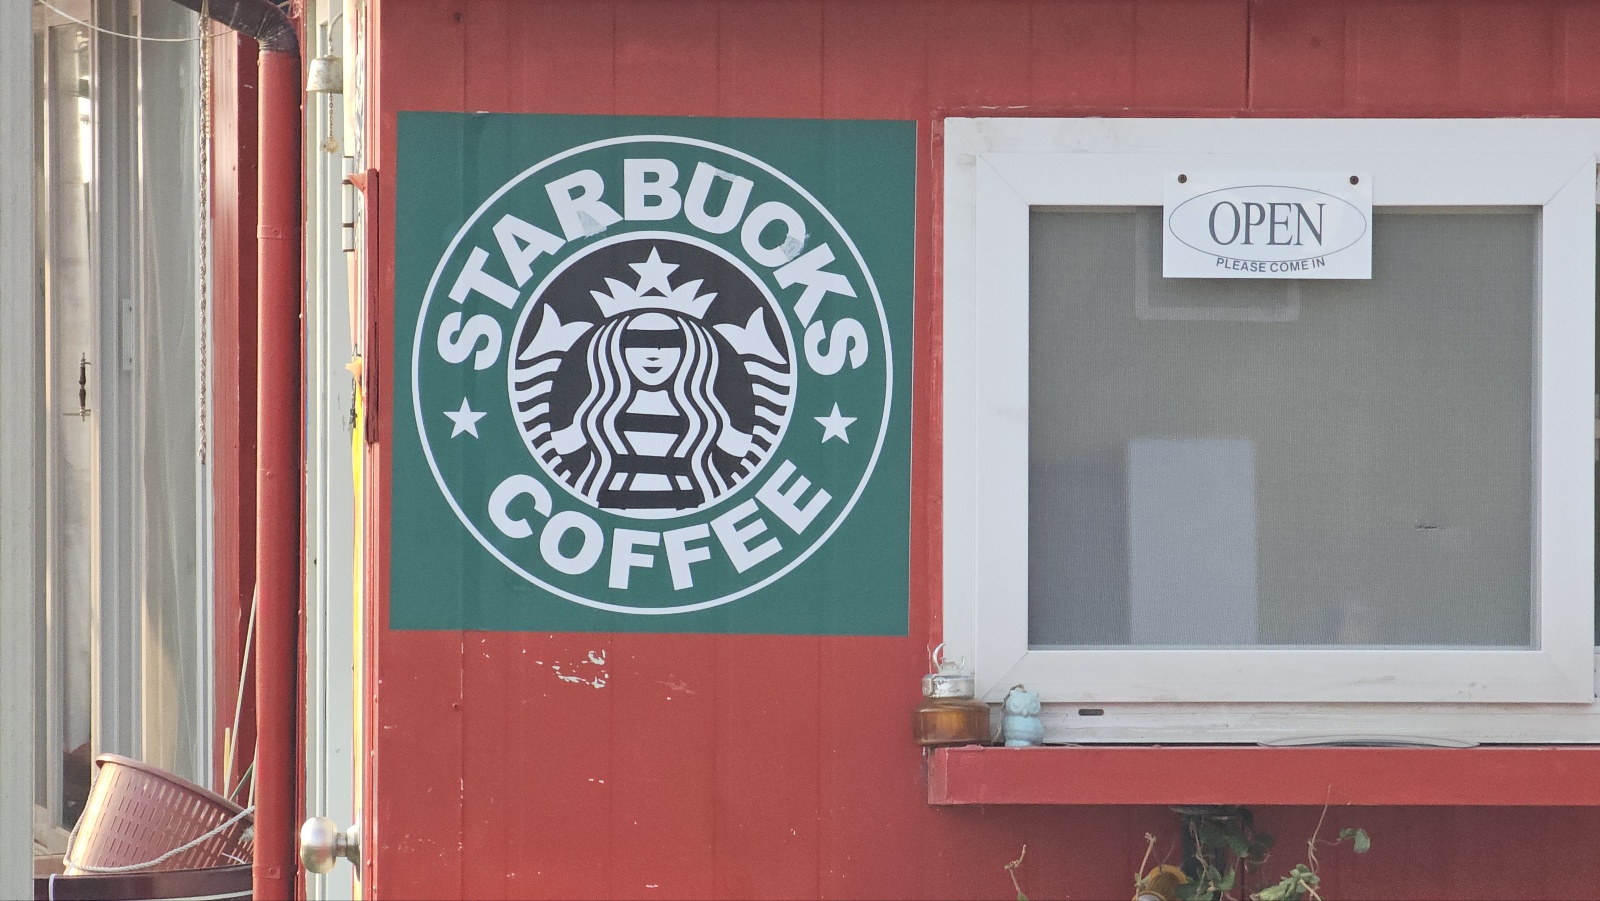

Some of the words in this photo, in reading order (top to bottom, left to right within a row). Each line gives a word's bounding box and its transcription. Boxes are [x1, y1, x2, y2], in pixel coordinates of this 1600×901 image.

[1208, 200, 1326, 247] OPEN
[1216, 257, 1266, 273] PLEASE
[1270, 259, 1309, 273] COME
[1312, 257, 1326, 269] IN
[488, 459, 833, 591] COFFEE
